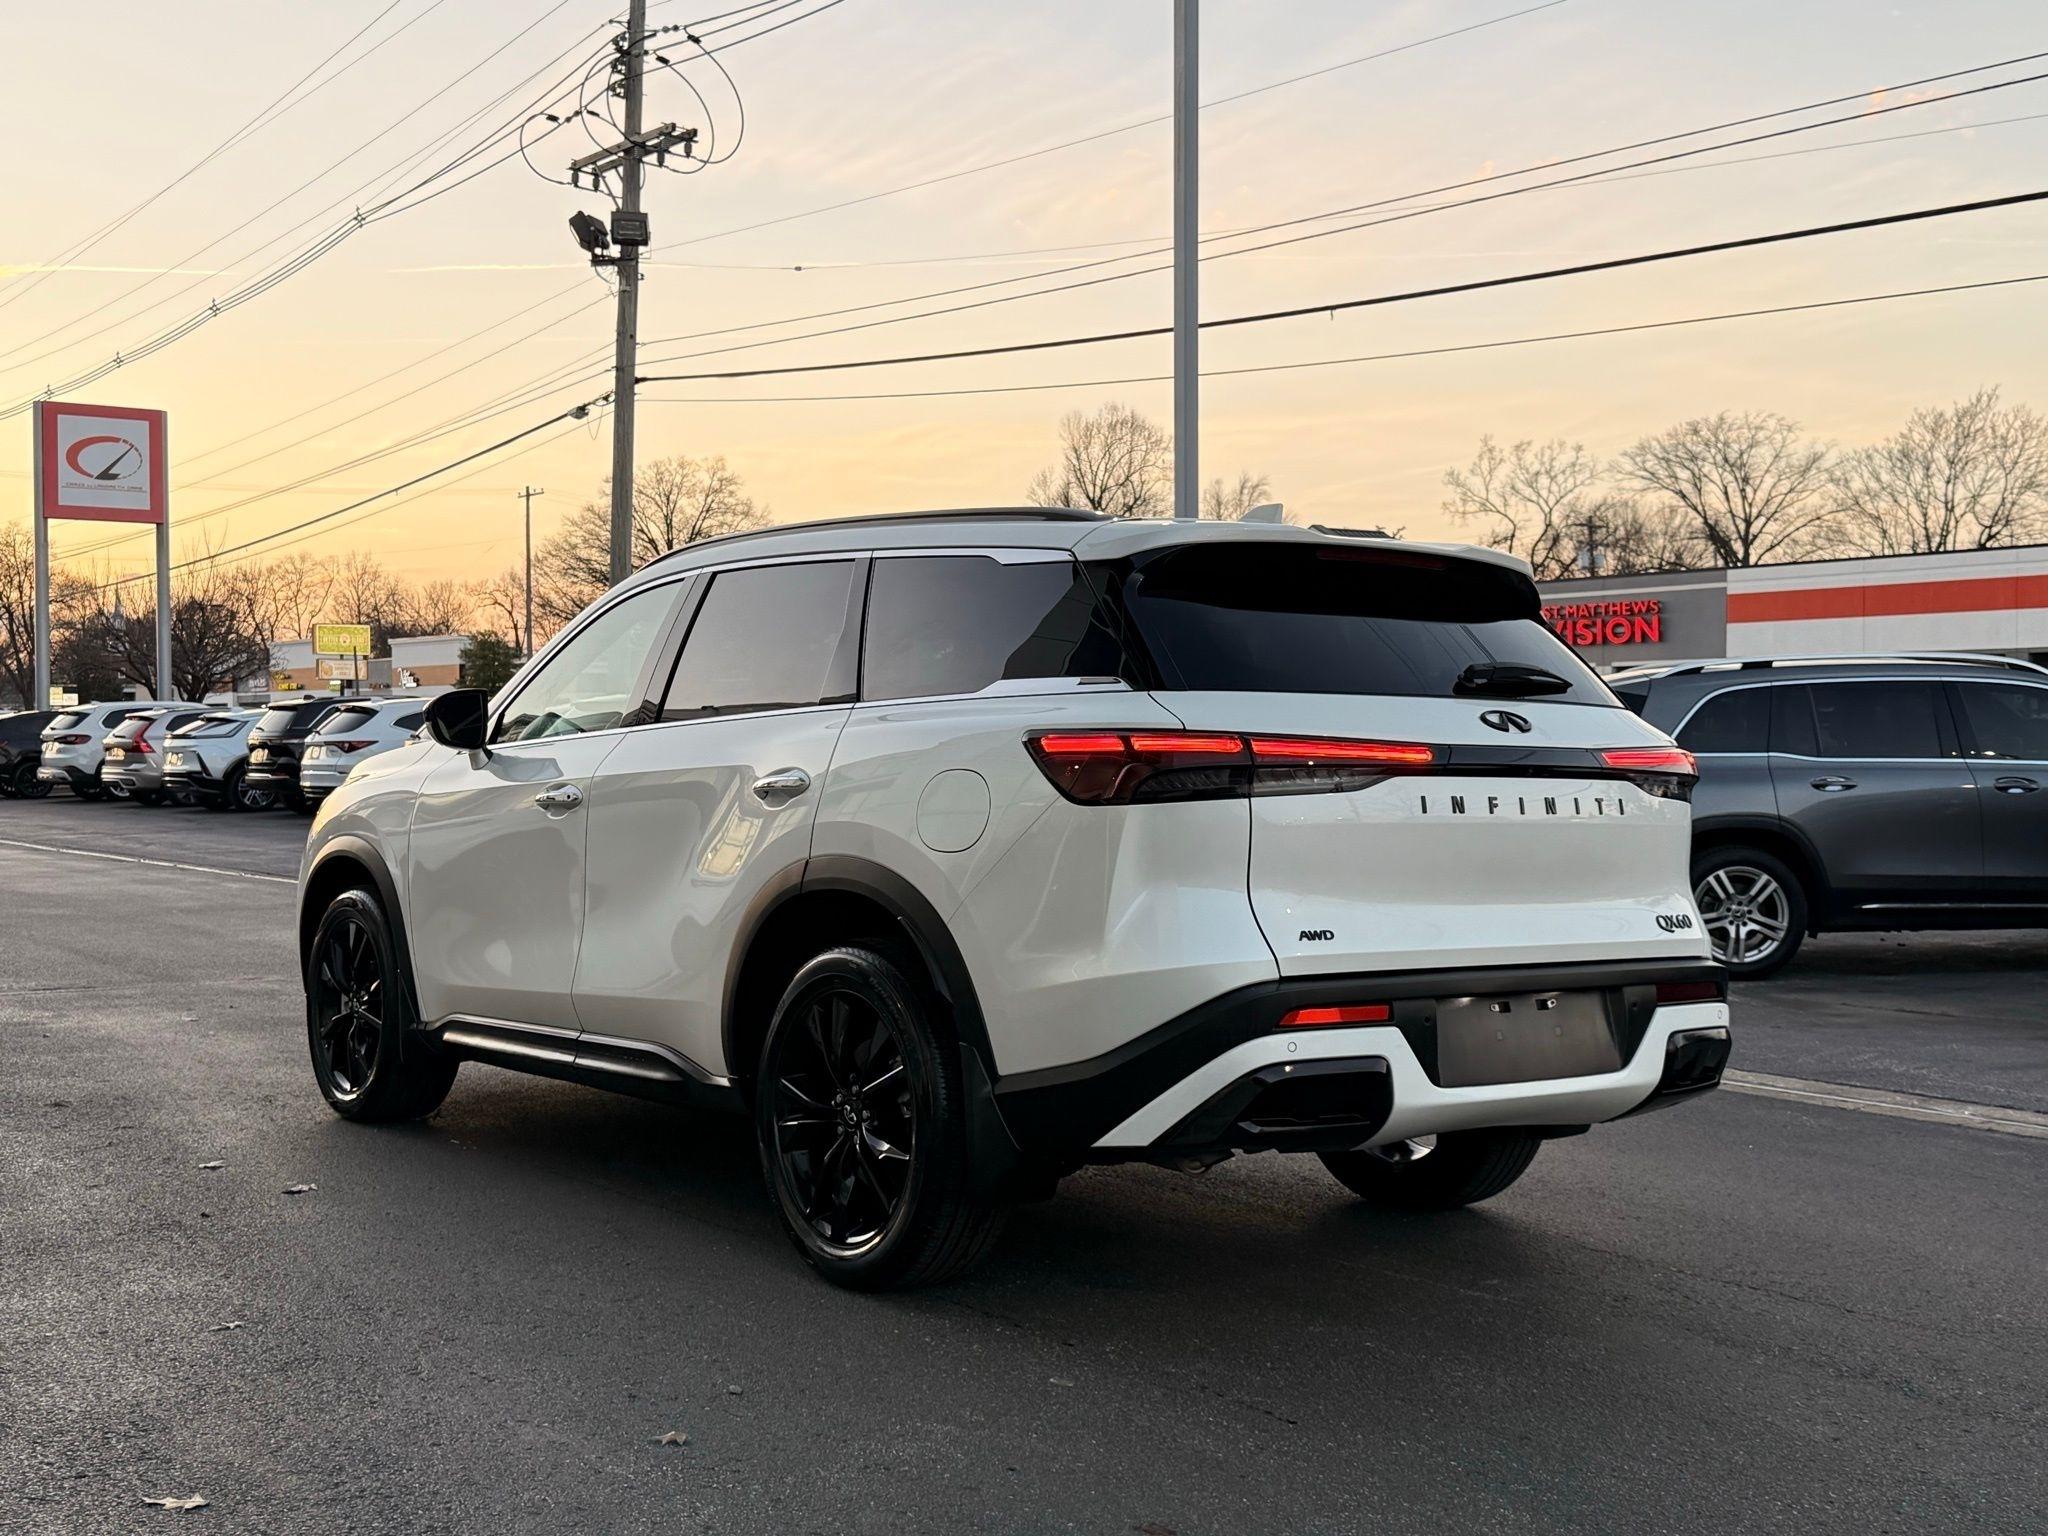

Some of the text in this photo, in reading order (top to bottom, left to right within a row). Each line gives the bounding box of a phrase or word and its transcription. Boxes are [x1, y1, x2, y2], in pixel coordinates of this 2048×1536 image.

[1565, 600, 1660, 618] MATTHEWS
[1420, 795, 1625, 815] INFINITI
[1655, 914, 1693, 933] QX60
[1298, 929, 1335, 941] AWD
